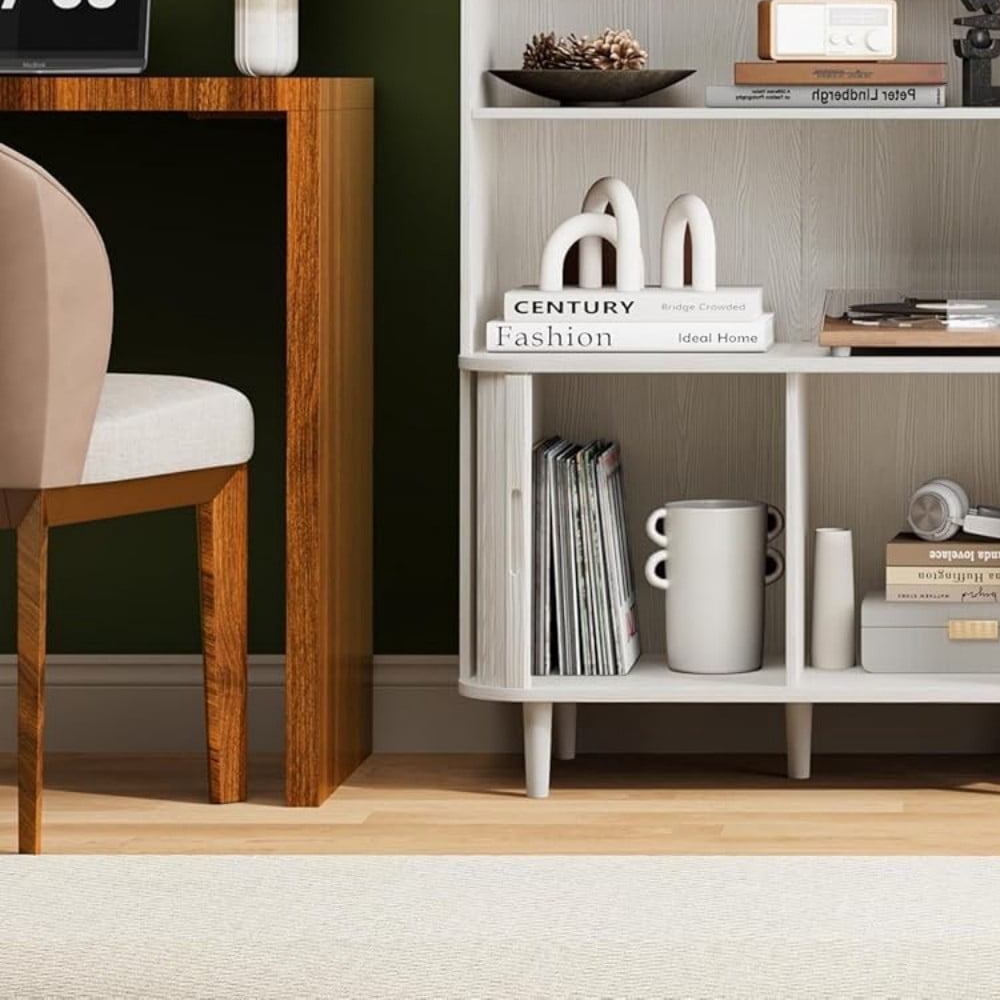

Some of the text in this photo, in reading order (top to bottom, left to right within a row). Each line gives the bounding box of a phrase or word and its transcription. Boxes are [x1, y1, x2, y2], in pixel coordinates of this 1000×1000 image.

[514, 301, 746, 314] CENTURY Bridge Crowded
[496, 326, 758, 347] Fashion Ideal Home
[929, 550, 975, 562] lovelace
[918, 570, 984, 583] Huffington
